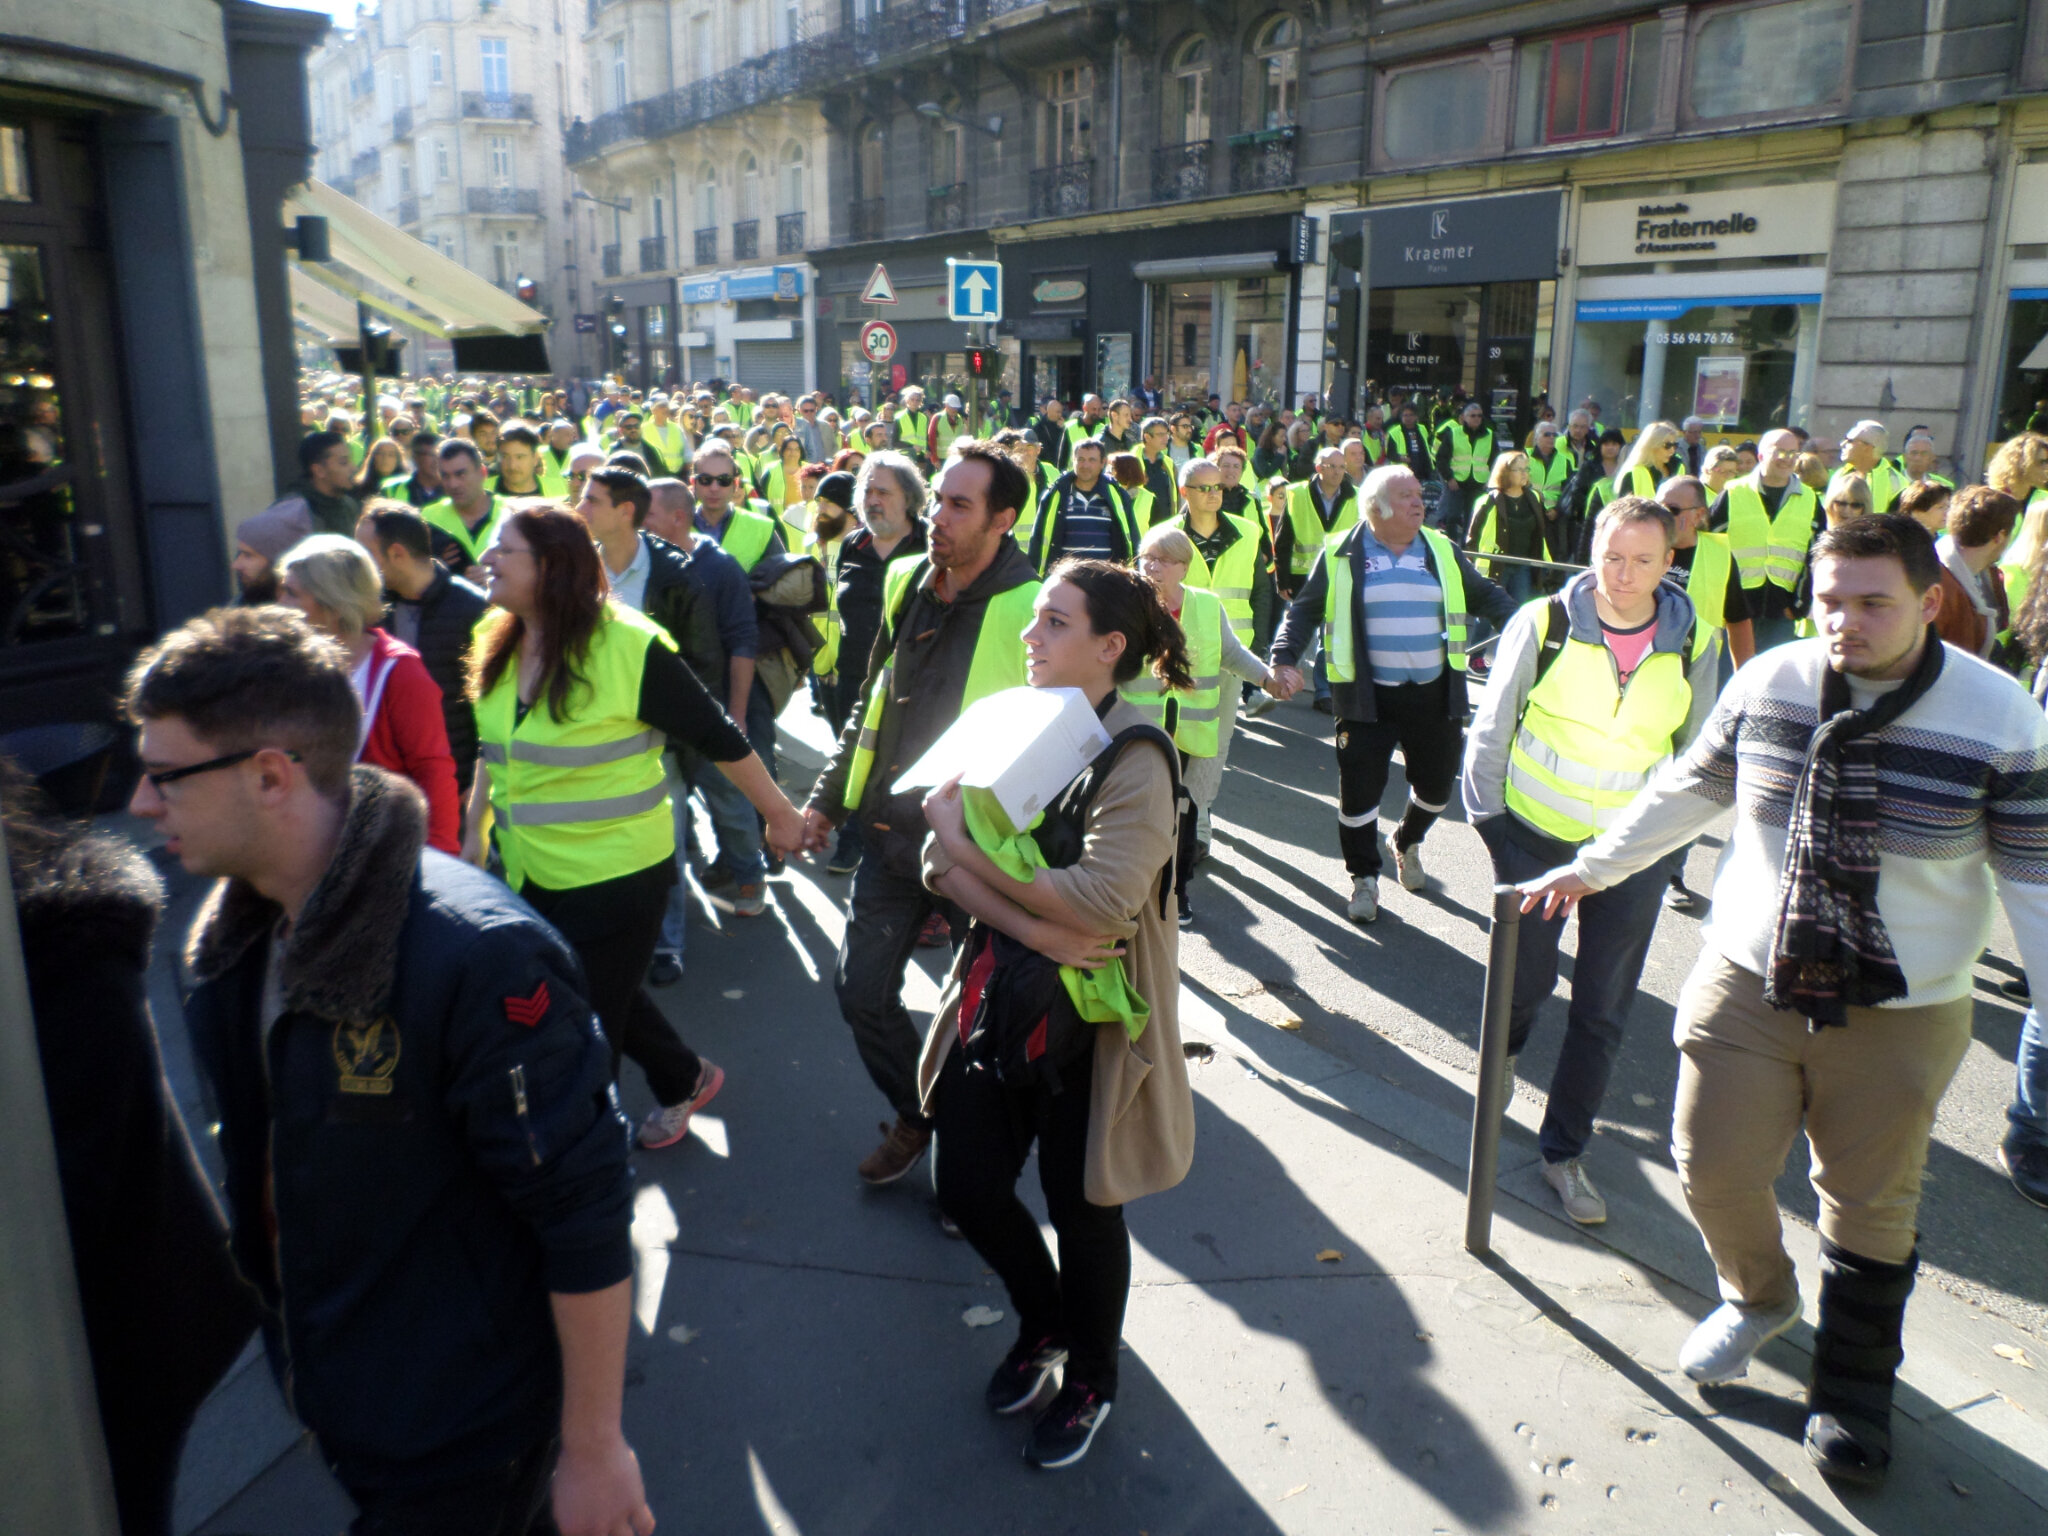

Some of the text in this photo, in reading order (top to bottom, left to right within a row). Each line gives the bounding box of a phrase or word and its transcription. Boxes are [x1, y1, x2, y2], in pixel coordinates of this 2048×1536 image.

[1638, 203, 1689, 217] Mutuelle
[1636, 212, 1757, 240] Fraternelle
[1405, 246, 1474, 262] Kraemer
[1635, 241, 1716, 254] d'Assurances
[698, 285, 716, 299] CSF
[870, 333, 890, 349] 30
[1656, 332, 1734, 344] 05 56 94 76 76
[1387, 353, 1440, 364] Kraemer
[1489, 347, 1501, 359] 39
